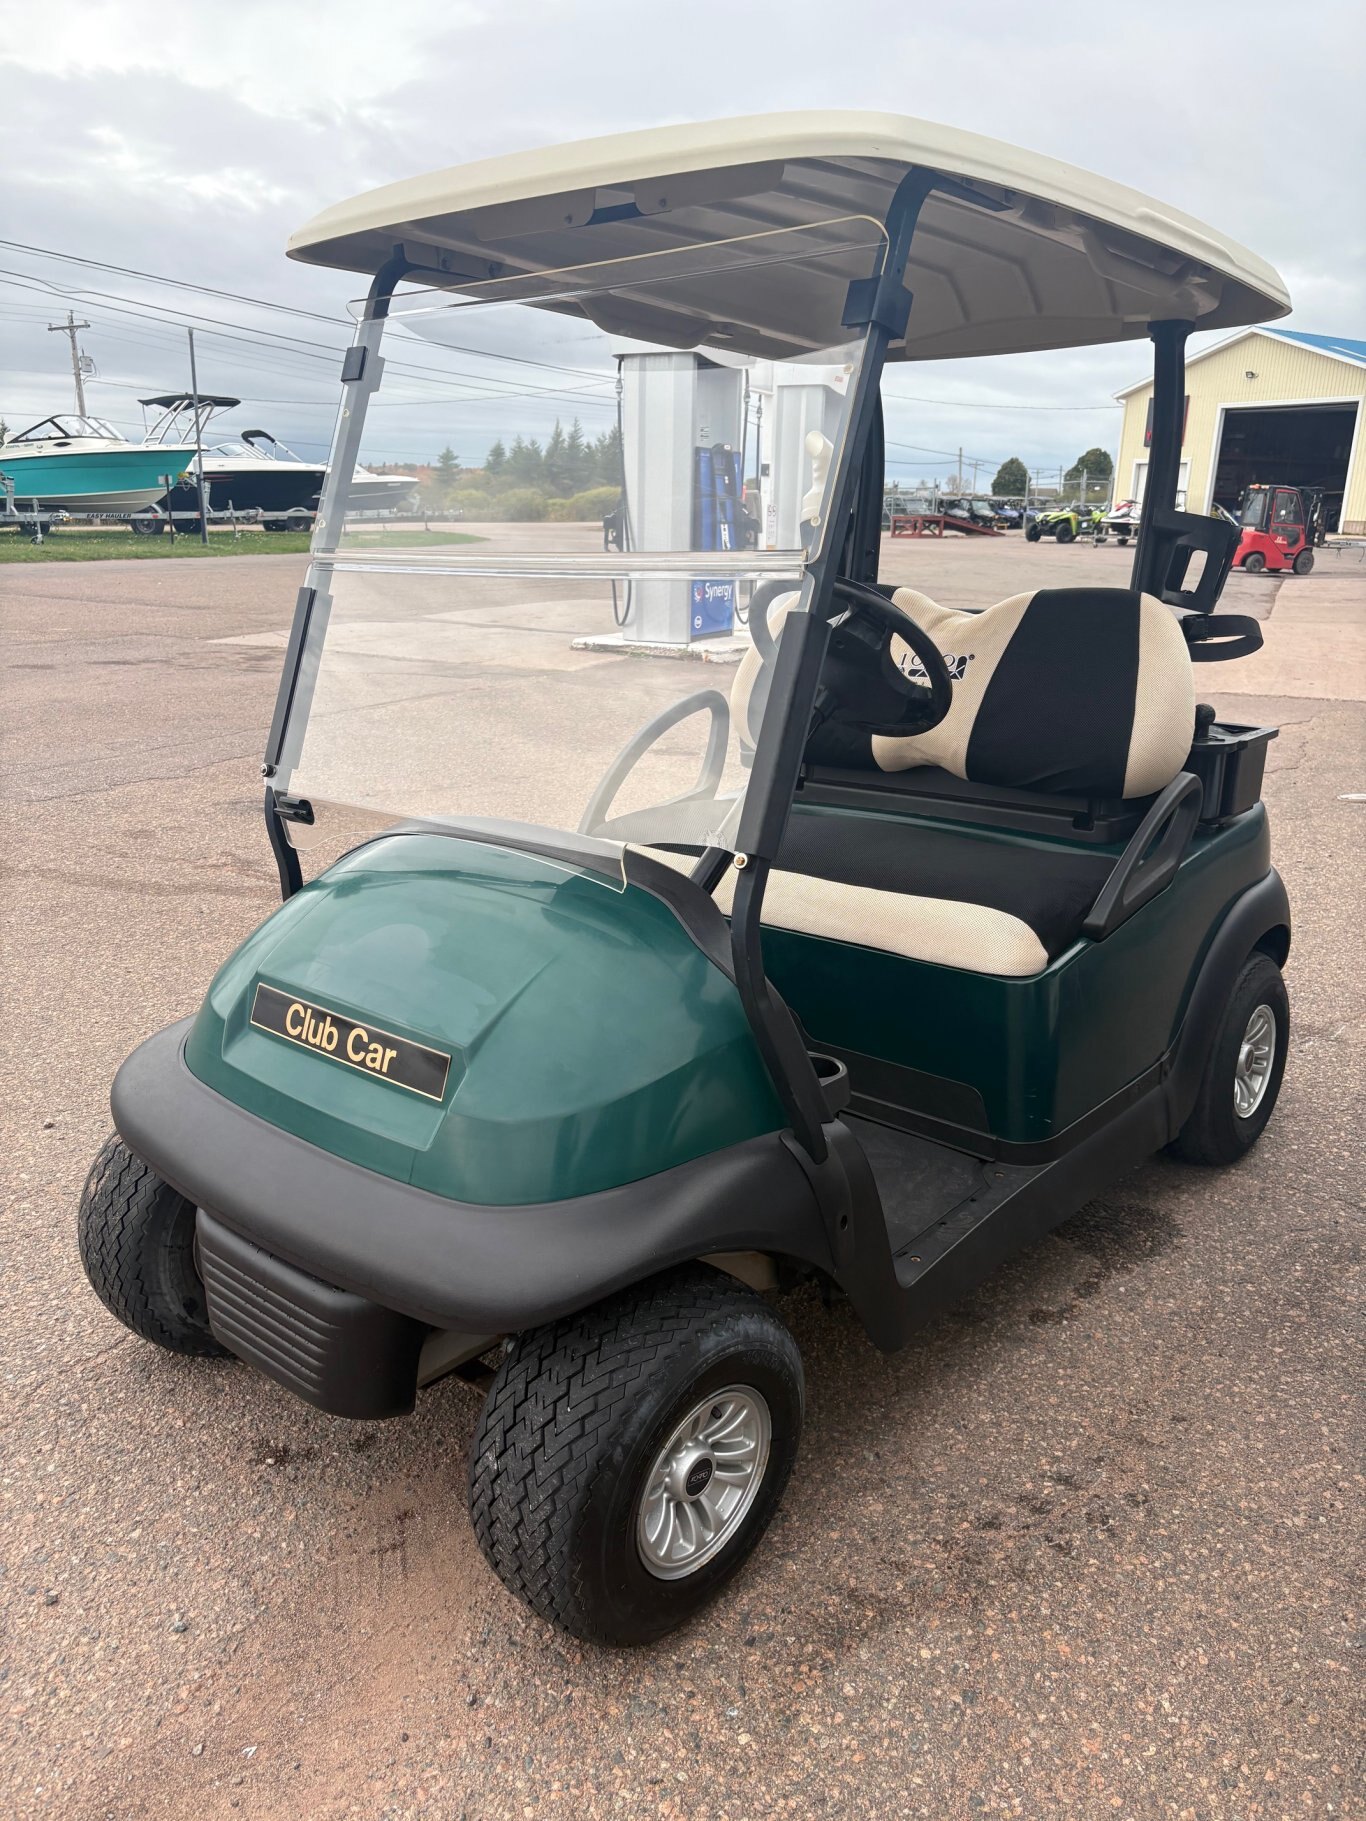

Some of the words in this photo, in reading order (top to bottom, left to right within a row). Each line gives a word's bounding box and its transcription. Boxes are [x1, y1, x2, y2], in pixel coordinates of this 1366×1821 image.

[705, 582, 733, 602] Synergy
[285, 1002, 339, 1052] Club
[346, 1027, 398, 1074] Car
